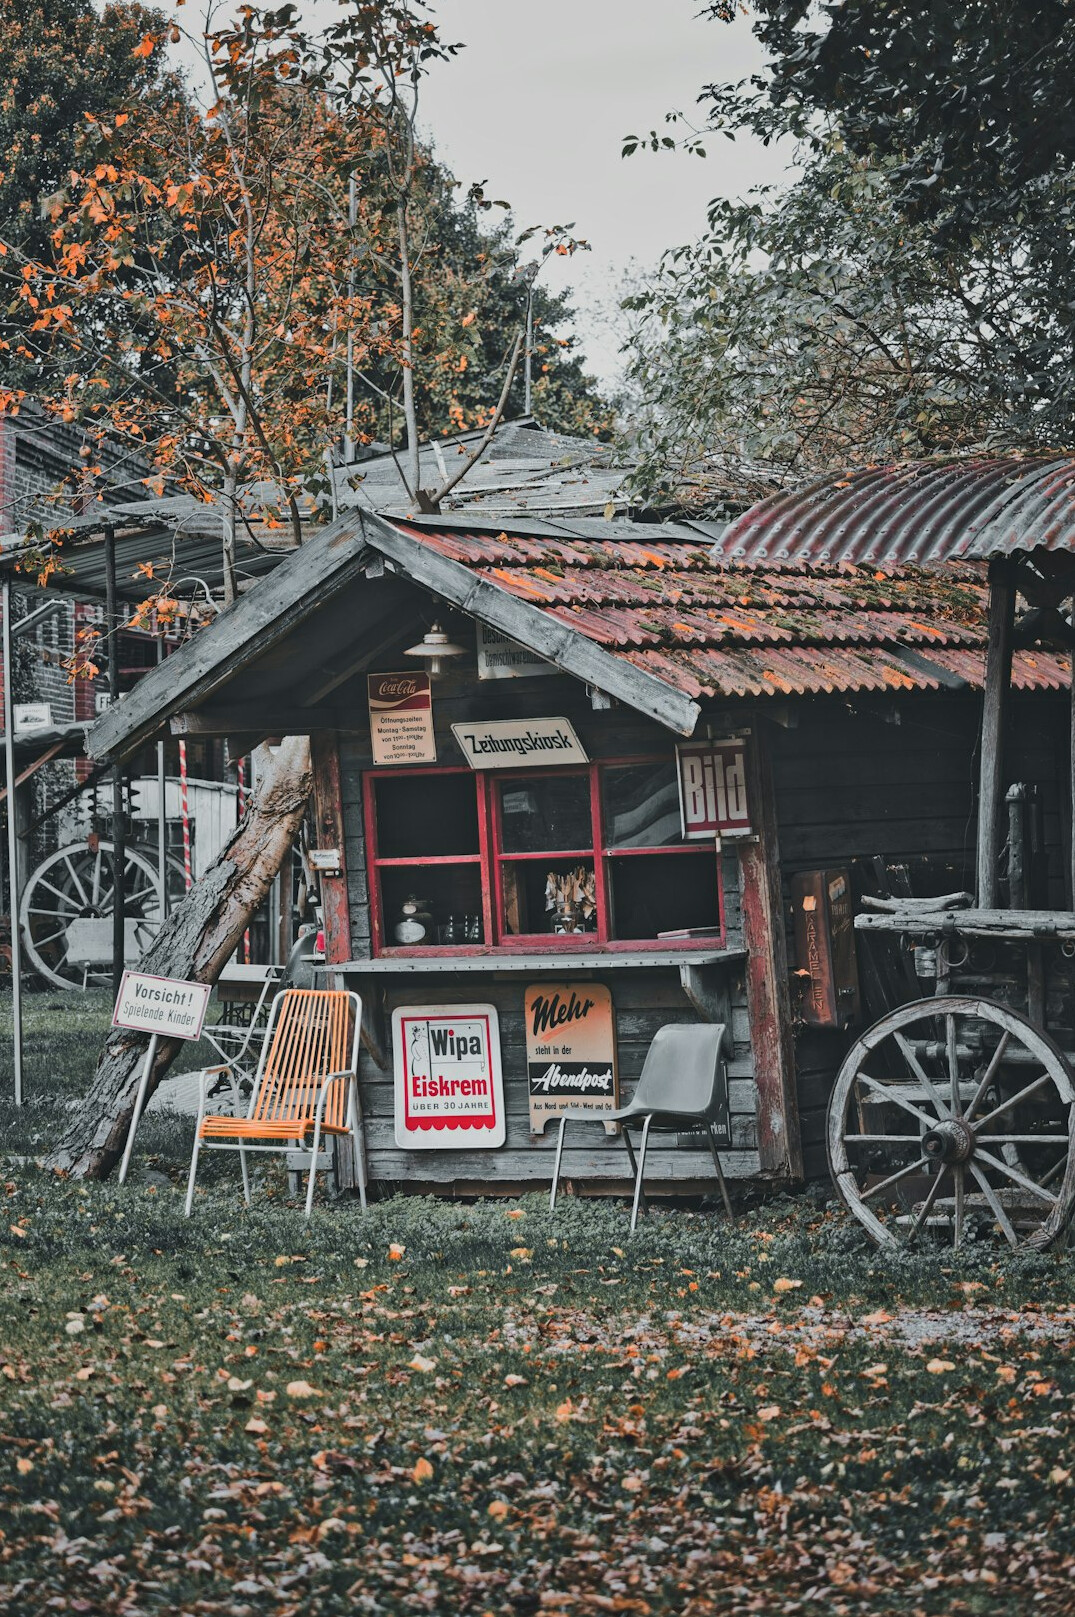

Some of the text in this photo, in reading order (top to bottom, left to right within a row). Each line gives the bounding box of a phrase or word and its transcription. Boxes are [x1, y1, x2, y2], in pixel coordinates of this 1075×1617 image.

[379, 680, 416, 696] Coca-Cola
[380, 715, 422, 724] Öffnungszeiten
[464, 730, 573, 754] Zeitungskiosk
[682, 753, 748, 823] Bild
[135, 982, 193, 1007] Vorsicht!
[123, 1001, 196, 1026] Spielende Kinder
[531, 992, 595, 1037] Mehr
[431, 1029, 482, 1061] Wipa
[535, 1044, 572, 1055] steht in der
[412, 1075, 488, 1097] Eiskrem
[531, 1063, 613, 1093] Abendpost
[413, 1101, 489, 1111] ÜBER 30 JAHRE
[534, 1102, 542, 1110] Aus
[544, 1102, 556, 1110] Nord
[559, 1102, 569, 1110] und
[595, 1102, 604, 1110] und
